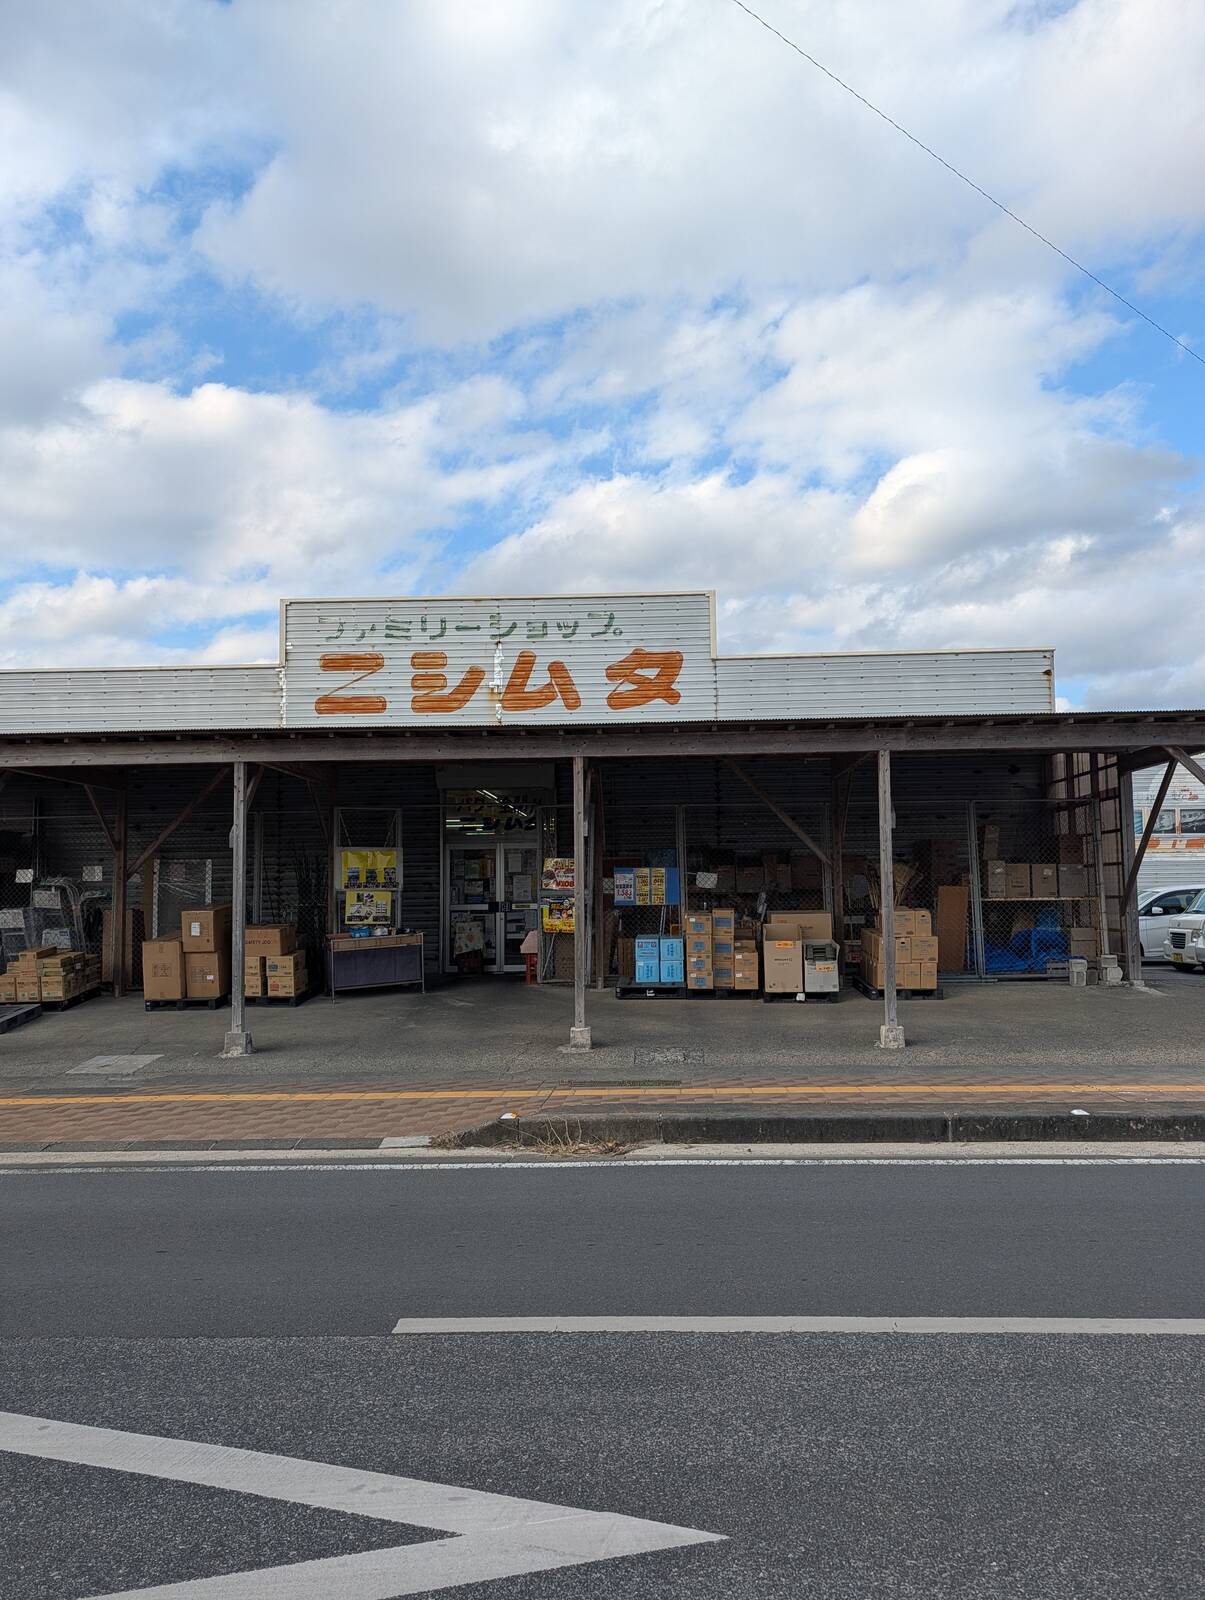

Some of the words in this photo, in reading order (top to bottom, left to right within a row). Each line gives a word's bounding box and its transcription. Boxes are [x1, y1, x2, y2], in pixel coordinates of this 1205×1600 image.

[318, 611, 624, 642] ファミリーショップ
[314, 647, 684, 715] ニシムタ
